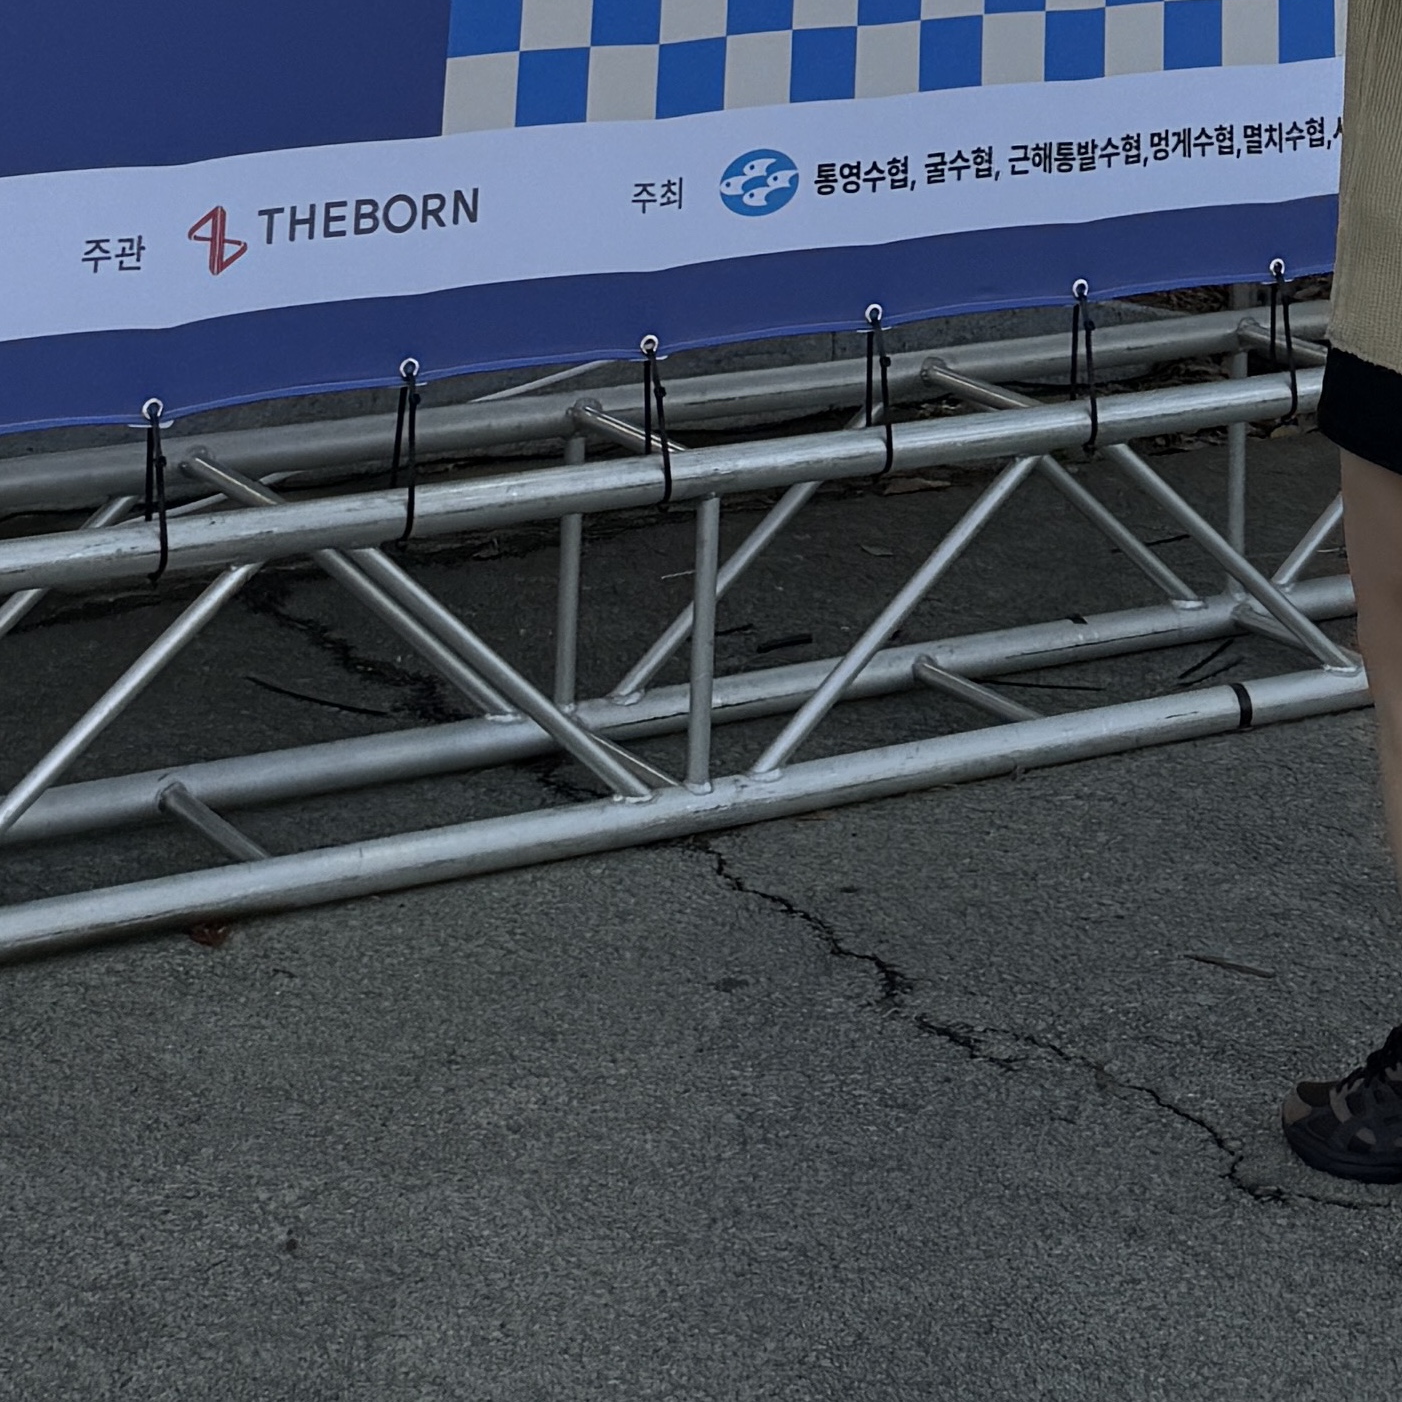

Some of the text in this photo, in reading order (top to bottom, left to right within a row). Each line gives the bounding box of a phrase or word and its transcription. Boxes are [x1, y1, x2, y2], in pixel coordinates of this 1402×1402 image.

[631, 176, 684, 214] 주최
[814, 155, 917, 196] 통영수협,
[924, 145, 1001, 185] 굴수협,
[257, 186, 480, 245] THEBORN
[81, 233, 147, 274] 주관
